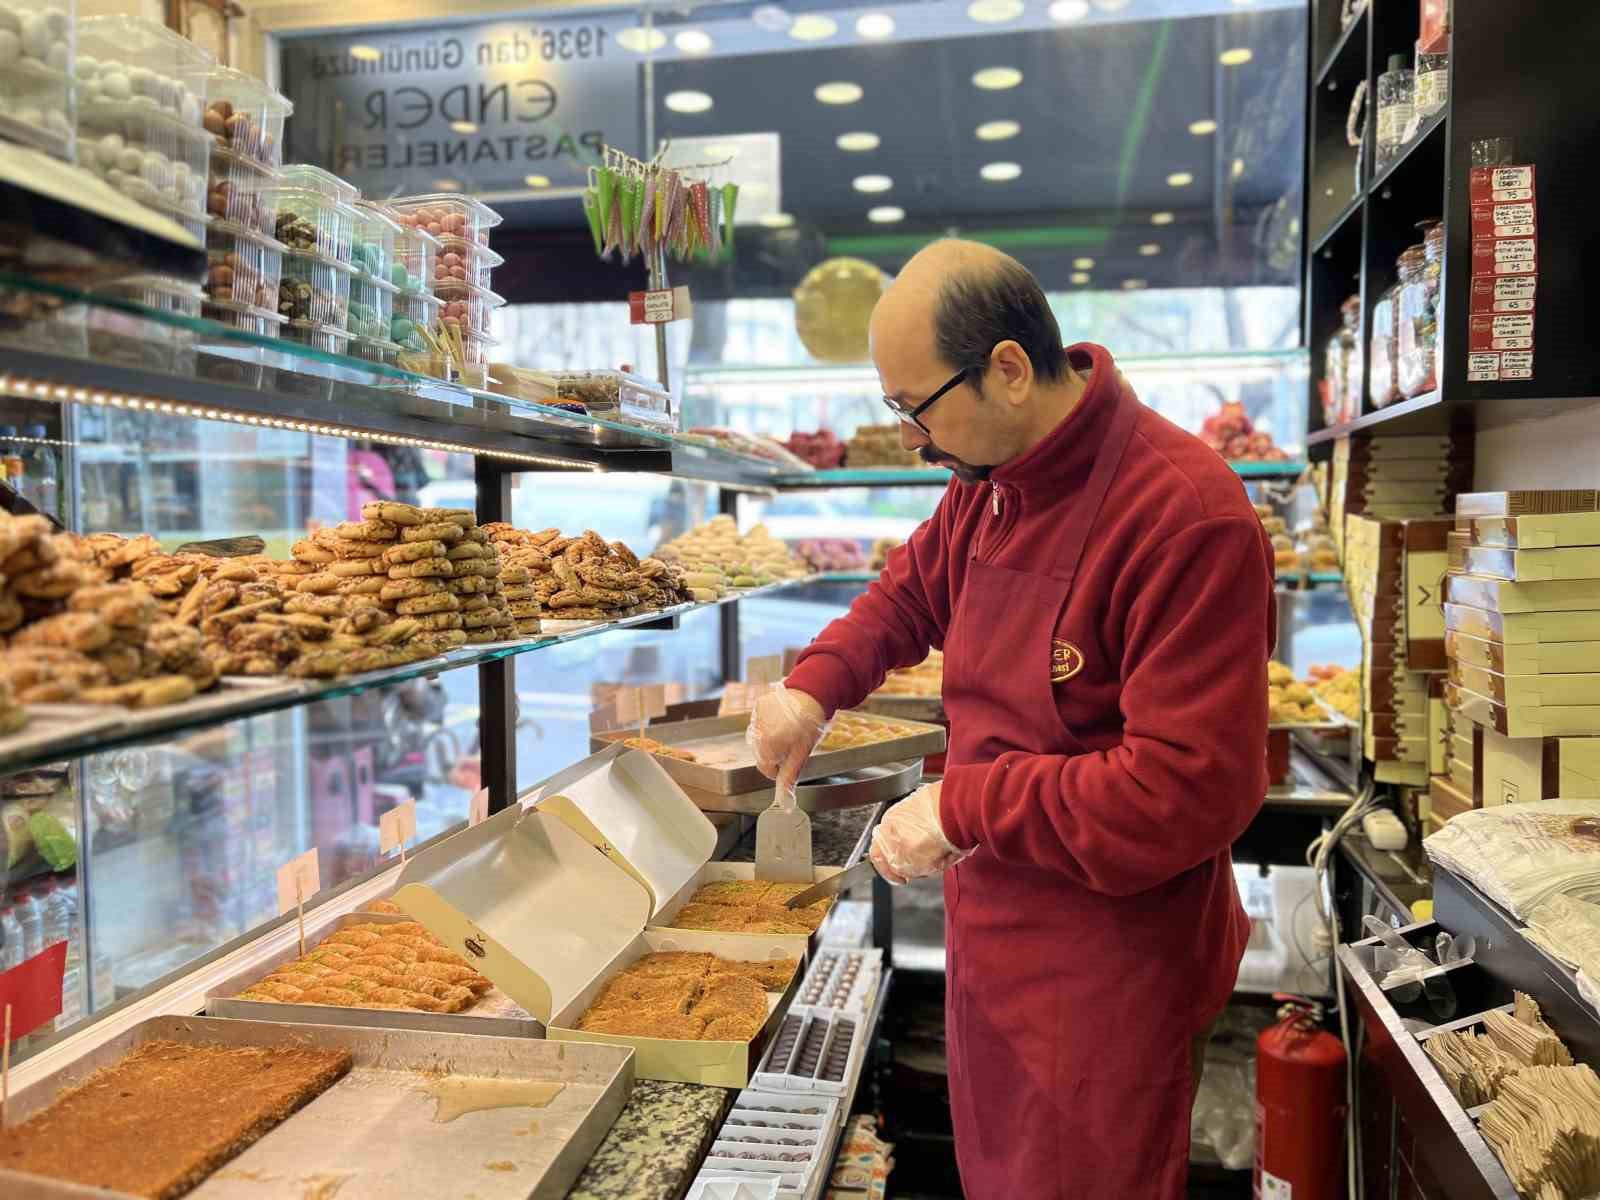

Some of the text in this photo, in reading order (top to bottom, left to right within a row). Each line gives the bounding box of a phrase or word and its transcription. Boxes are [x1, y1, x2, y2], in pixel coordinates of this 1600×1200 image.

[1506, 190, 1517, 198] 75
[1512, 226, 1521, 234] 75
[1511, 263, 1520, 271] 75
[1053, 648, 1070, 660] ER
